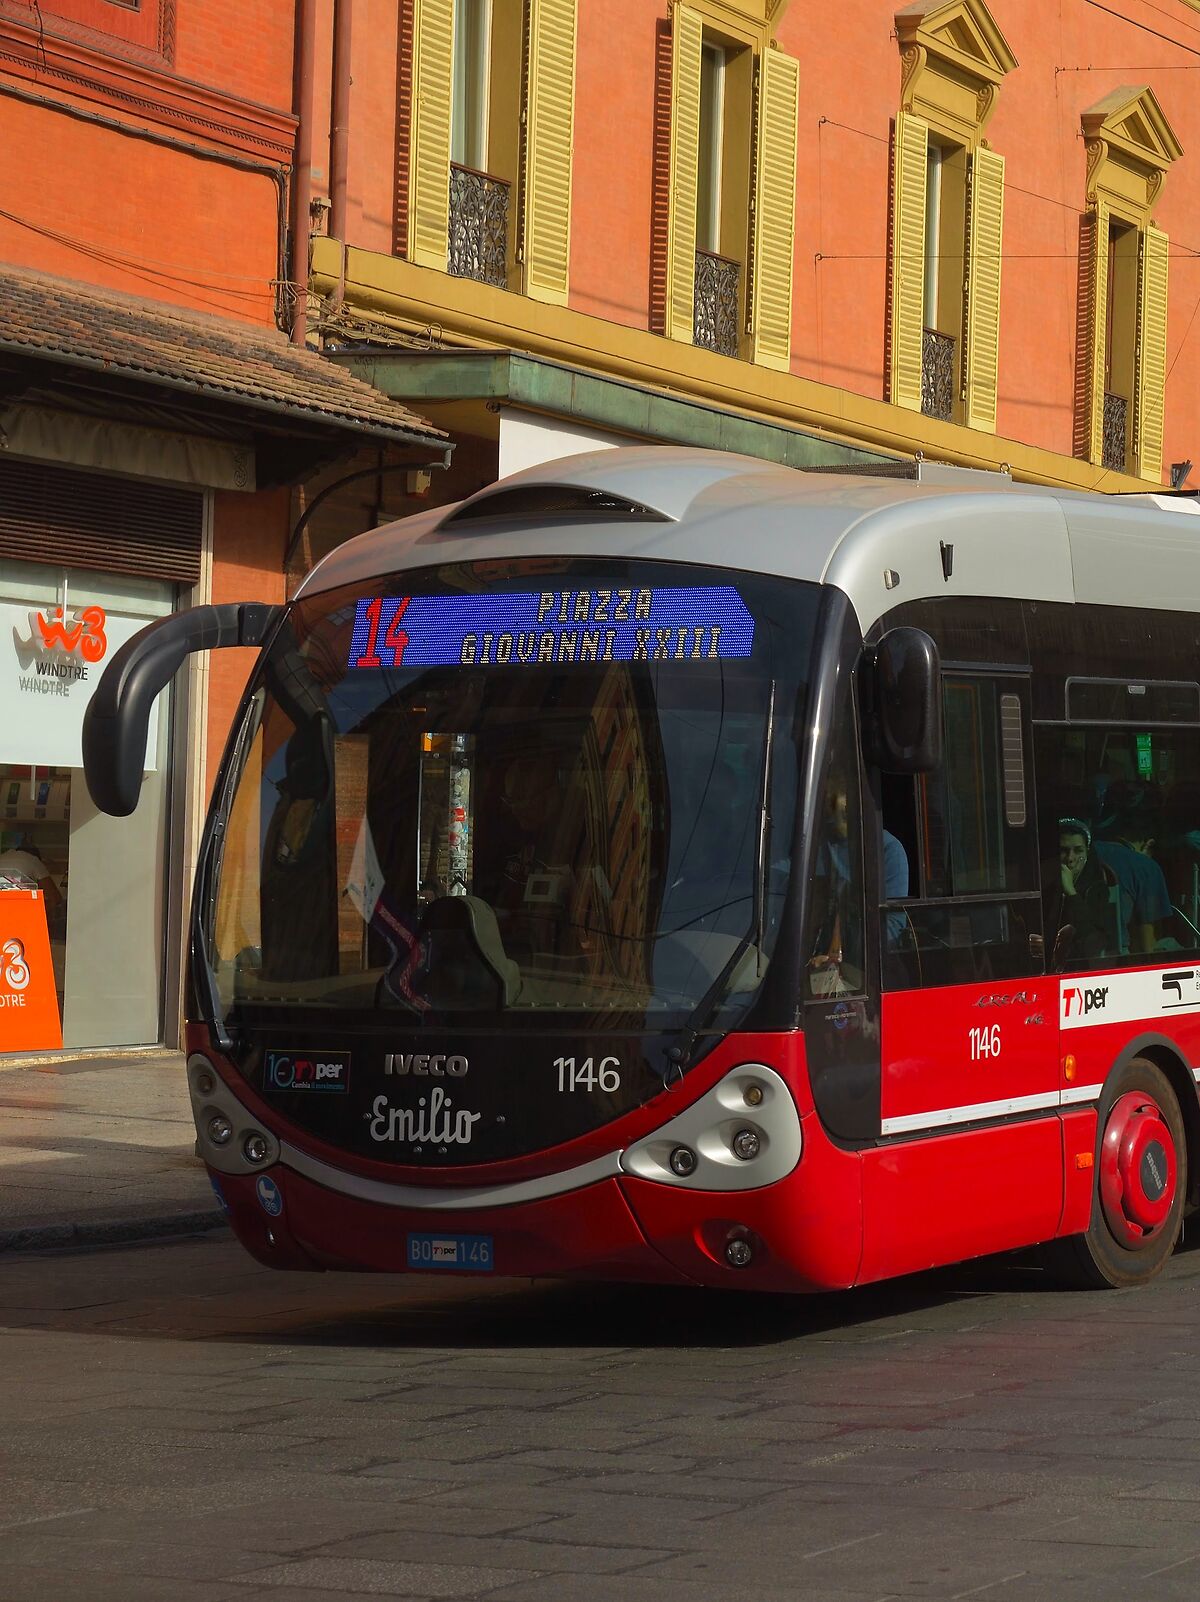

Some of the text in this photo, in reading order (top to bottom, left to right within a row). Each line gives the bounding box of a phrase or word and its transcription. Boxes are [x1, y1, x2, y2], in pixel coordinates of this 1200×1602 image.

[537, 589, 653, 622] PIAZZA
[356, 597, 411, 667] 14
[459, 627, 722, 664] GIOVANNI XXIII
[36, 661, 89, 681] WINDTRE
[968, 1024, 1001, 1060] 1146
[384, 1054, 469, 1077] IVECO
[553, 1056, 621, 1093] 1146
[370, 1087, 481, 1144] Emilio
[411, 1240, 431, 1260] BO
[460, 1241, 489, 1263] 146
